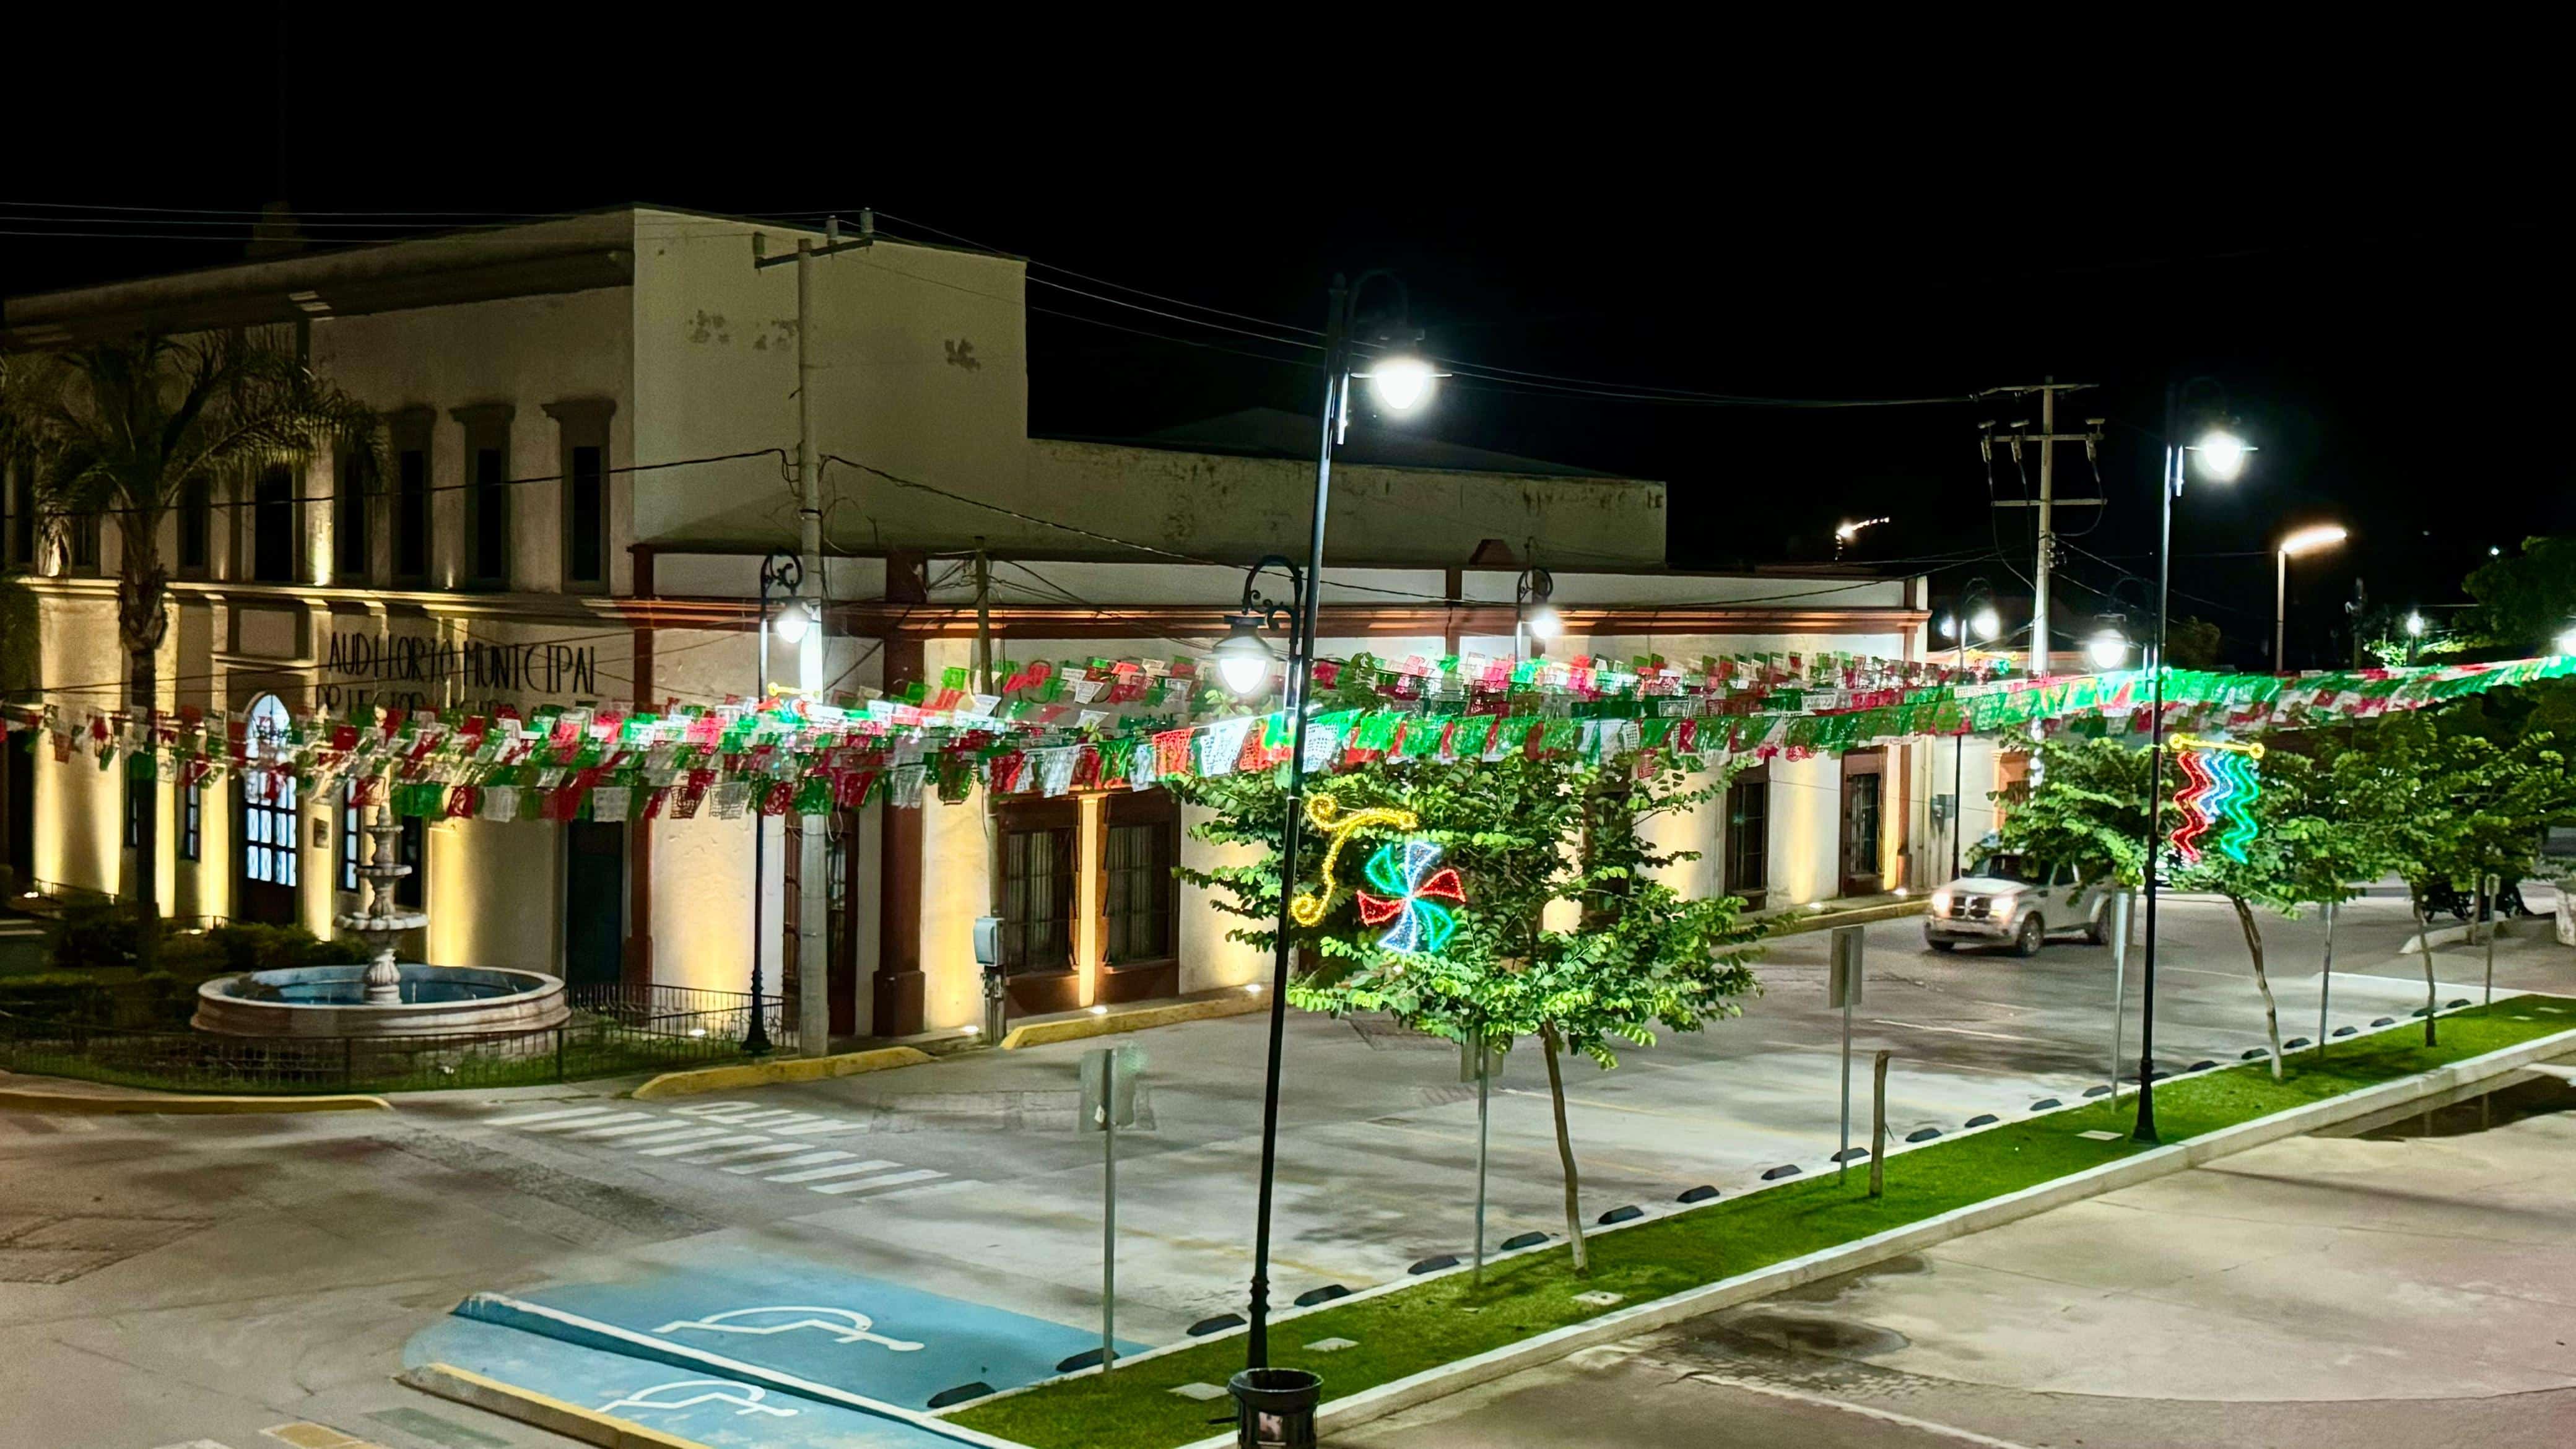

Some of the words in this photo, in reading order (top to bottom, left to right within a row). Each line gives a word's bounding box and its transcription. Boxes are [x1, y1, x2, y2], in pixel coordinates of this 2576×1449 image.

[329, 631, 454, 682] AUDITORIO
[463, 642, 604, 695] MUNICIPAL
[668, 1101, 868, 1135] ALTO
